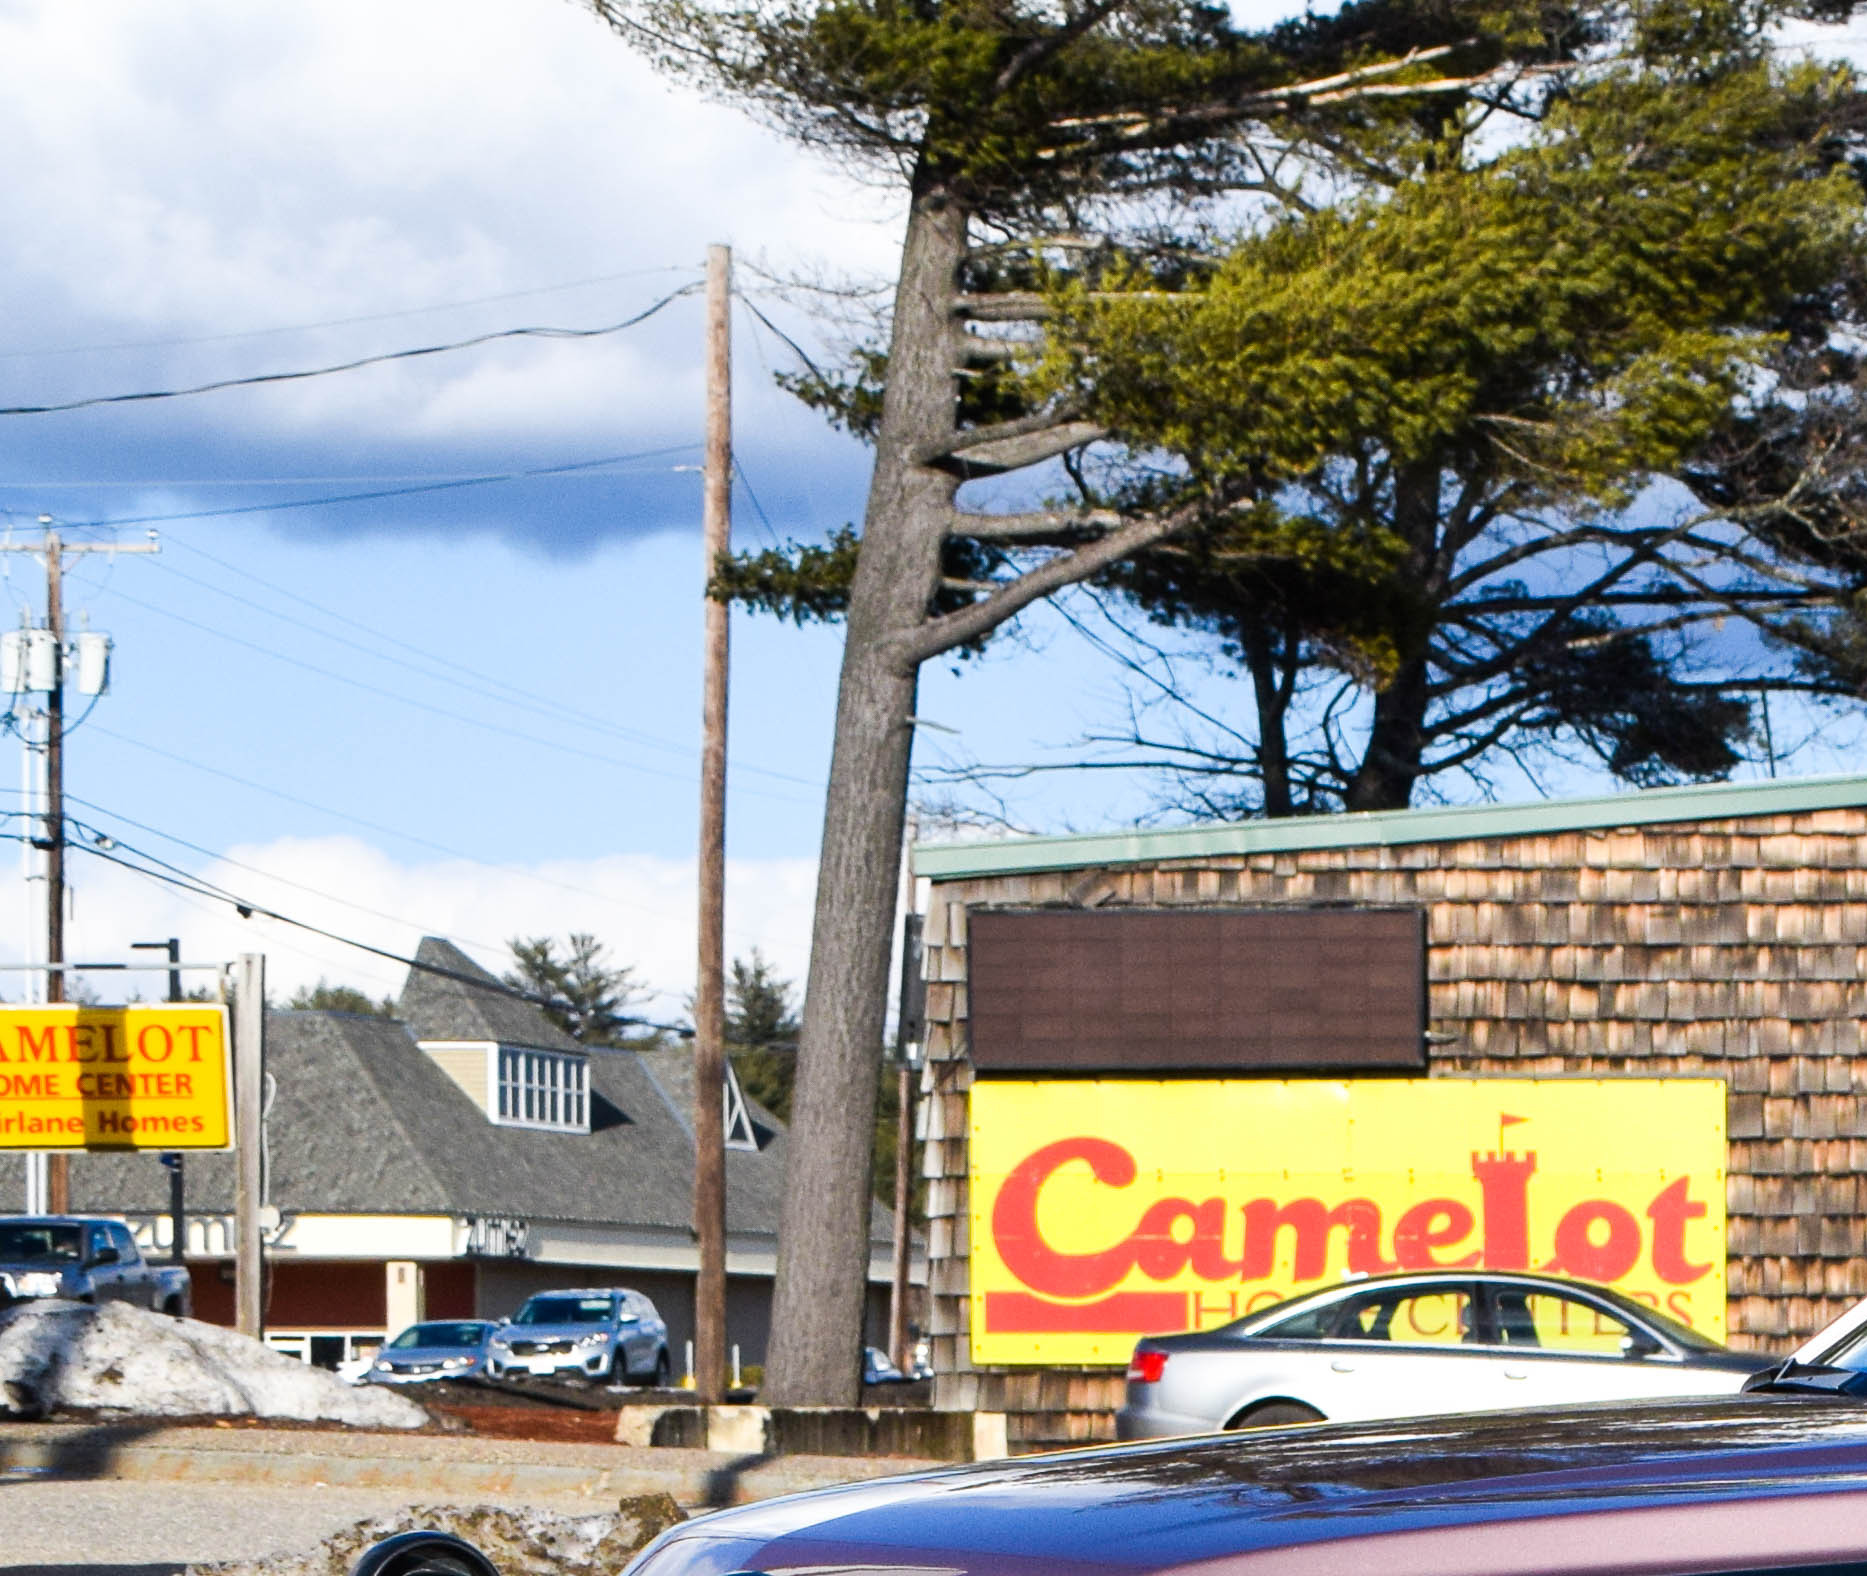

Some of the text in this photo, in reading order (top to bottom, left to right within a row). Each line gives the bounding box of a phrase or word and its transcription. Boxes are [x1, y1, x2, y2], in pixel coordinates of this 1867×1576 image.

[0, 1024, 212, 1063] MELOT
[76, 1073, 193, 1097] CENTER
[97, 1111, 204, 1133] Homes
[992, 1136, 1714, 1306] Camelot
